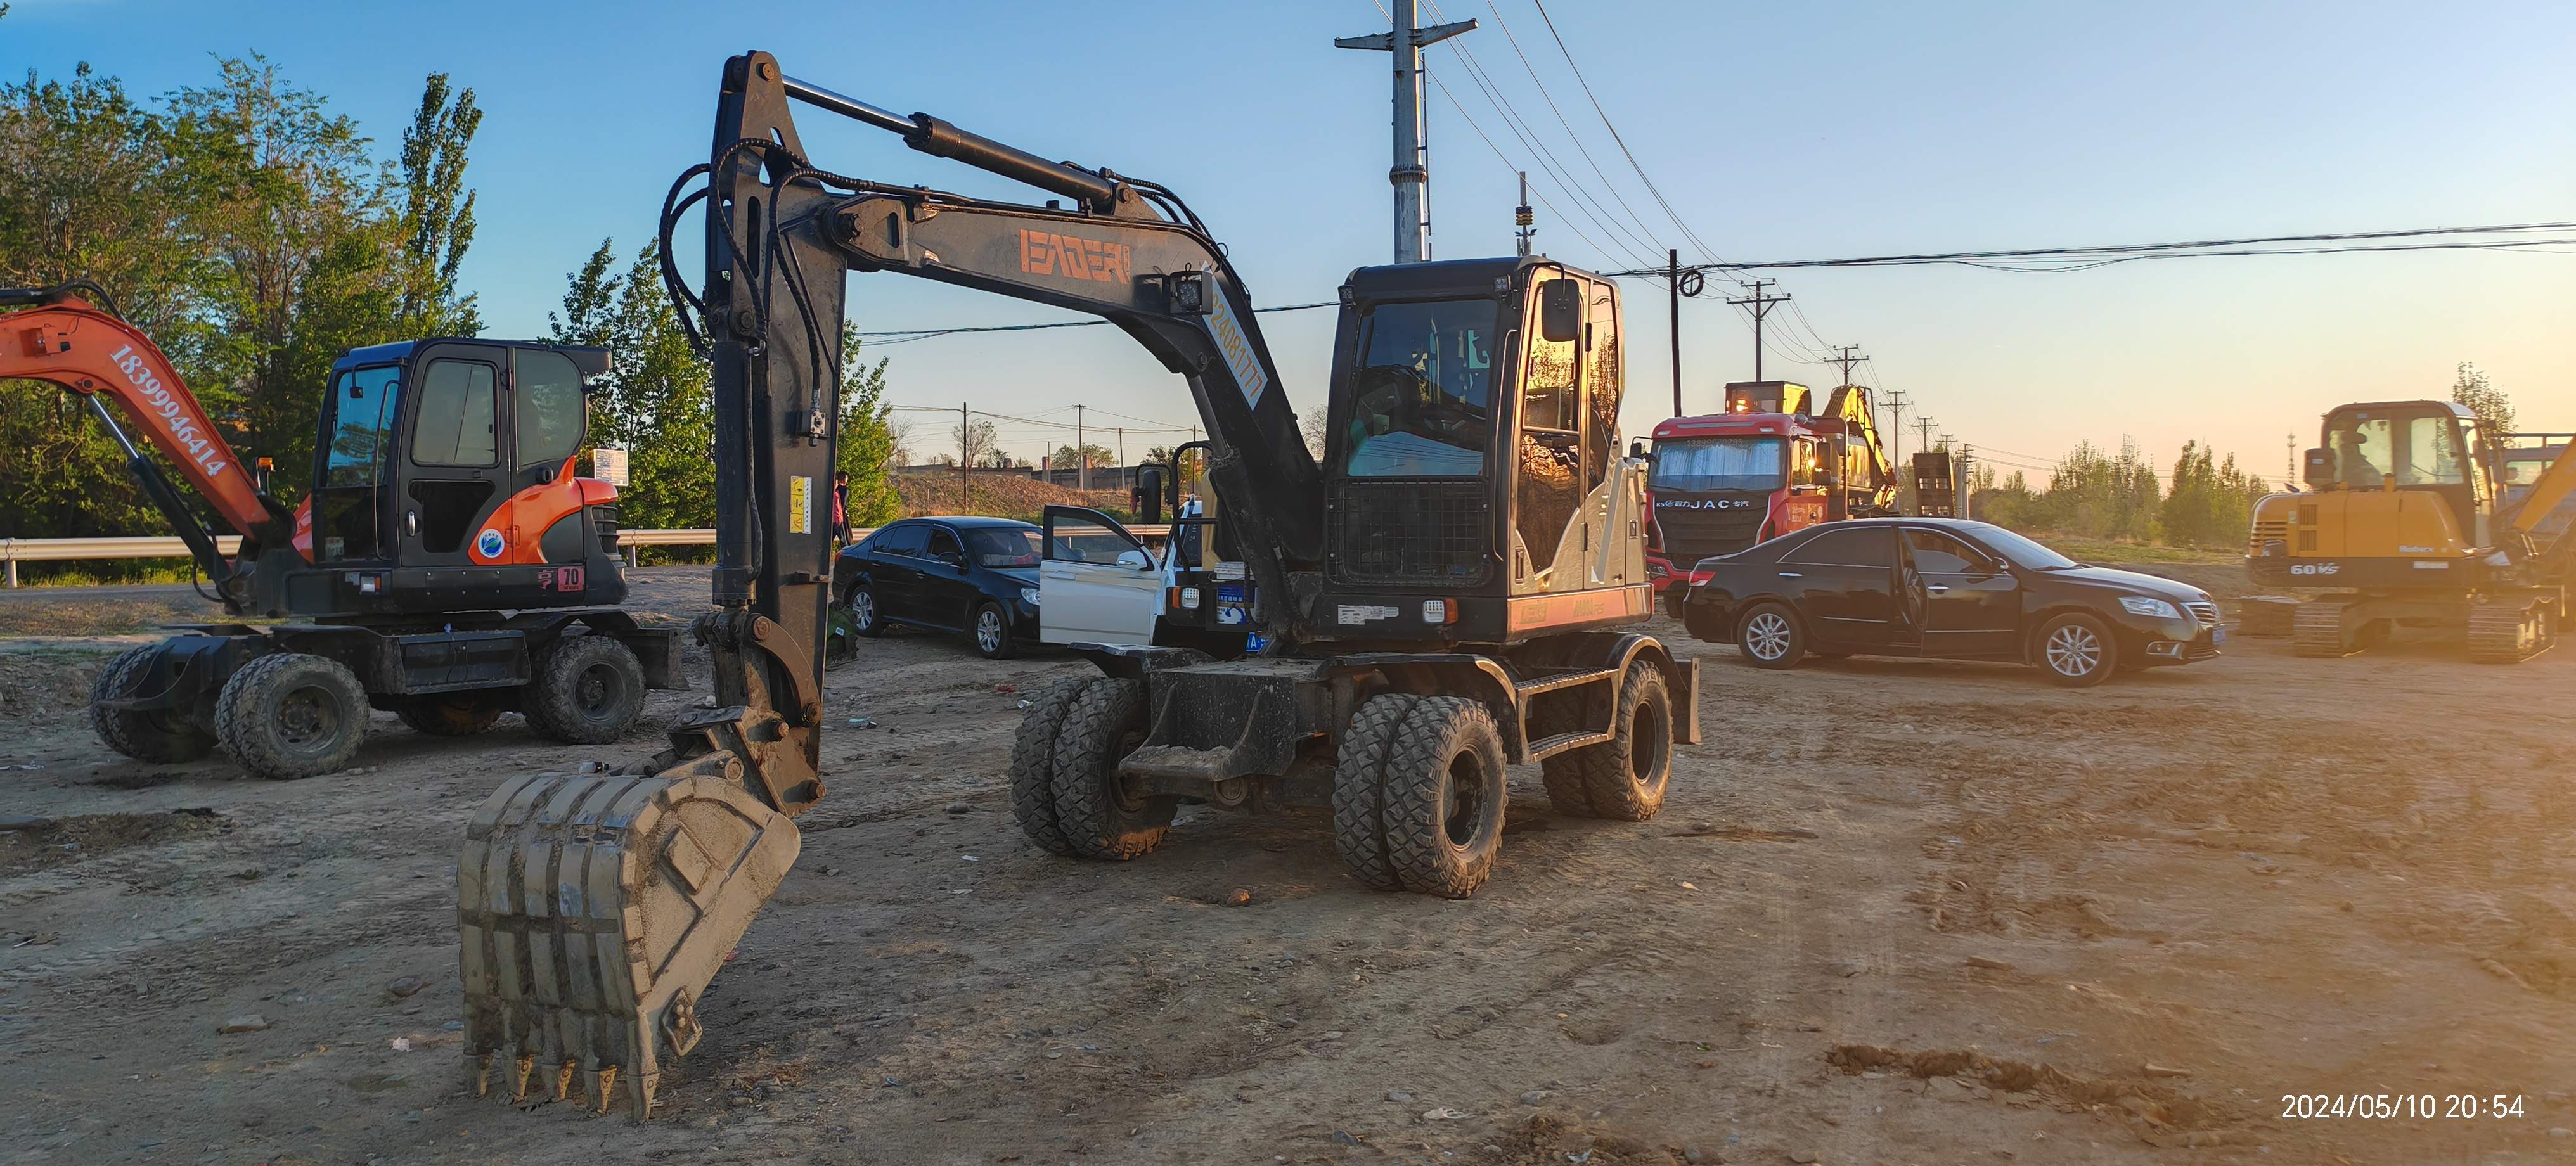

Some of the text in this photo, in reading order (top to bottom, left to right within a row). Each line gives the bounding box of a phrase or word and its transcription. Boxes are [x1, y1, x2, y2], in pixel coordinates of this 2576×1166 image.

[110, 344, 226, 477] 18399946414
[1690, 499, 1730, 509] JAC
[564, 568, 579, 586] 70
